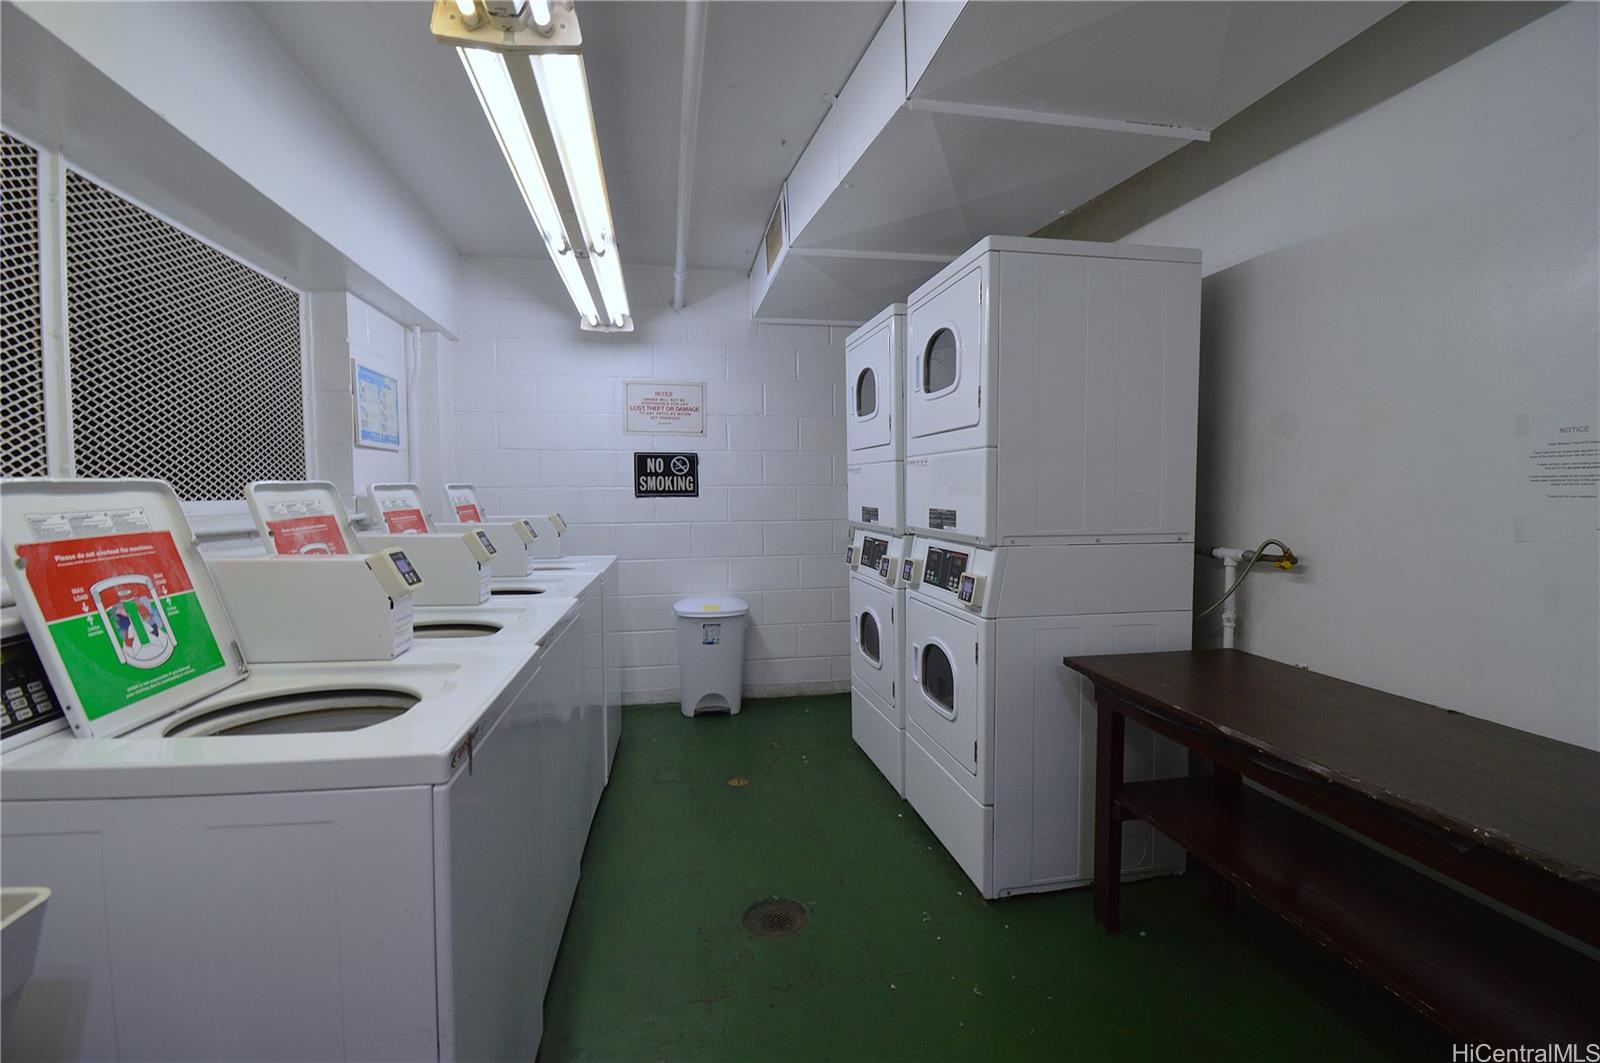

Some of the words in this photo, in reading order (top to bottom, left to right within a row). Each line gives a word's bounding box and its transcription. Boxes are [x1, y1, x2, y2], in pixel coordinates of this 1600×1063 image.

[646, 458, 664, 473] NO
[640, 476, 694, 491] SMOKING
[54, 554, 76, 562] Please
